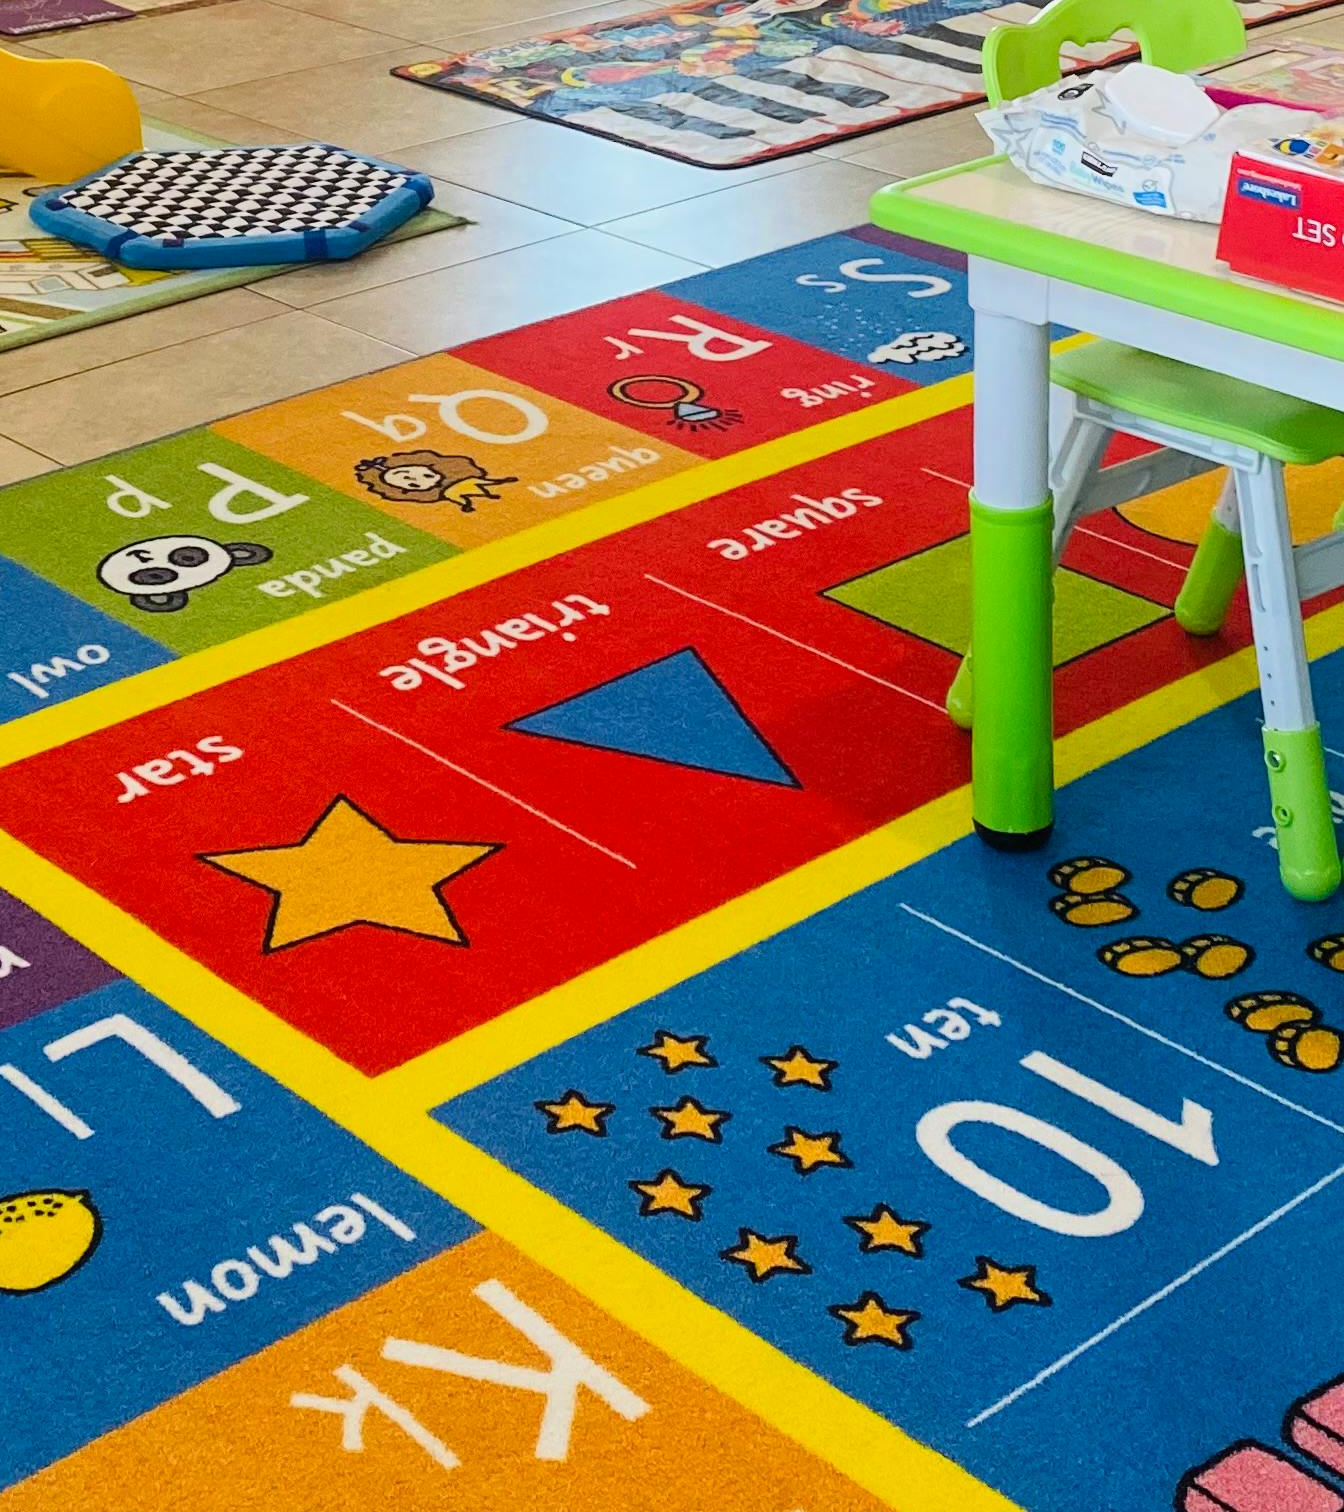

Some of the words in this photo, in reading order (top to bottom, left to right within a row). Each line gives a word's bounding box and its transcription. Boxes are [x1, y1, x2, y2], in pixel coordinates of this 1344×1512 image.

[1240, 180, 1299, 207] Lakeshore
[1291, 215, 1337, 248] SET
[779, 373, 877, 409] ring
[526, 443, 662, 501] queen
[706, 486, 885, 564] square
[256, 531, 409, 603] panda
[6, 641, 112, 701] owl
[377, 592, 612, 695] triangle
[115, 733, 245, 808] star
[884, 993, 1005, 1063] ten
[915, 1049, 1220, 1238] 10
[155, 1191, 418, 1327] lemon
